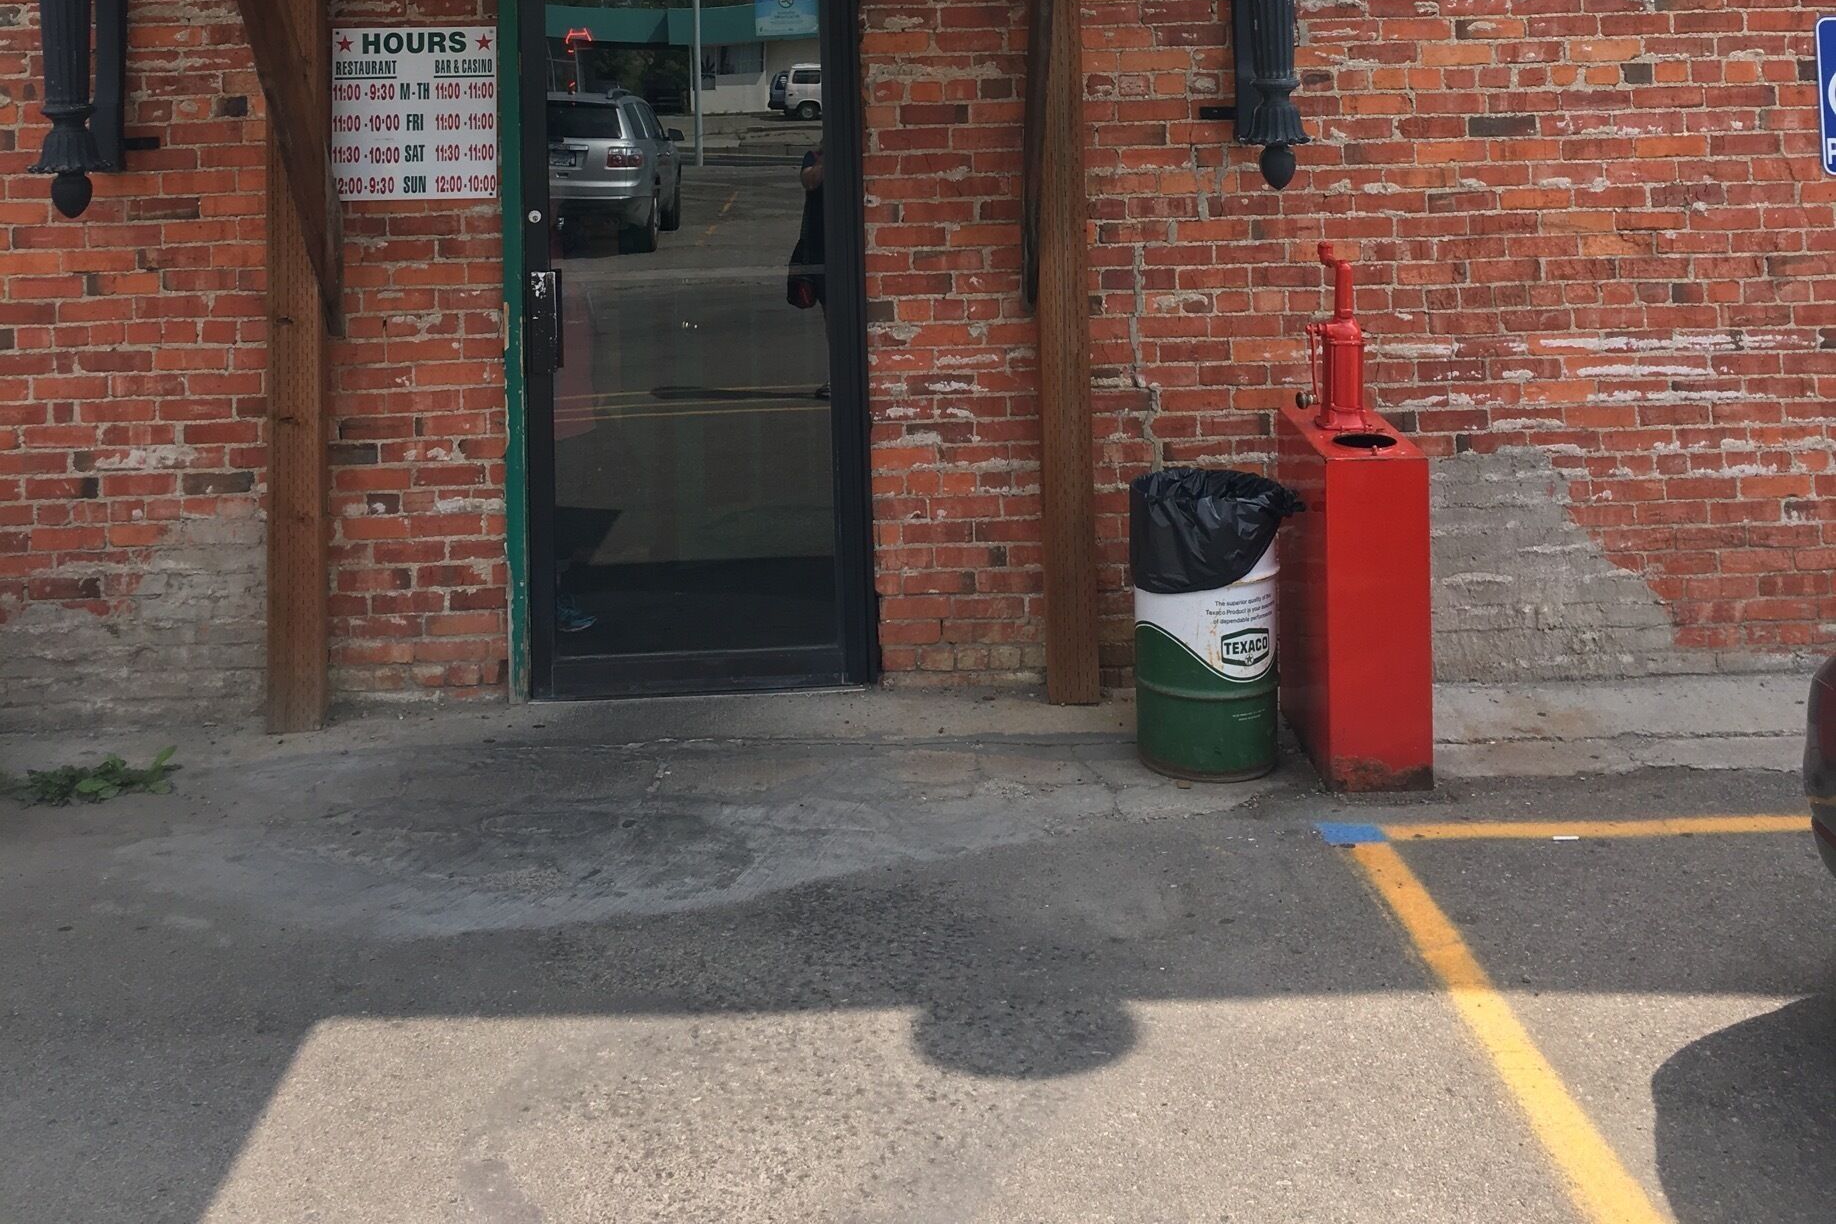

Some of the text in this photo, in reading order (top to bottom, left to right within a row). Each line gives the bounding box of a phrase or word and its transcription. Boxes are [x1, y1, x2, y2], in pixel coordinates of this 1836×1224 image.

[362, 31, 467, 54] HOURS
[336, 60, 397, 75] RESTAURANT
[435, 59, 493, 74] BAR & CASINO
[333, 84, 361, 101] 11:00
[369, 83, 395, 101] 9:30
[435, 82, 460, 100] 11:00
[468, 82, 494, 99] 11:00
[333, 114, 361, 132] 11:00
[406, 113, 424, 131] FRI
[435, 113, 460, 131] 11:00
[468, 113, 494, 130] 11:00
[333, 146, 360, 164] 11:30
[369, 146, 400, 164] 10:00
[404, 144, 425, 162] SAT
[435, 144, 460, 162] 11:30
[468, 144, 494, 161] 11:00
[335, 177, 363, 195] 2:00
[369, 176, 395, 195] 9:30
[403, 176, 427, 194] SUN
[435, 175, 462, 193] 12:00
[468, 175, 496, 192] 10:00
[1224, 636, 1268, 655] TEXACO
